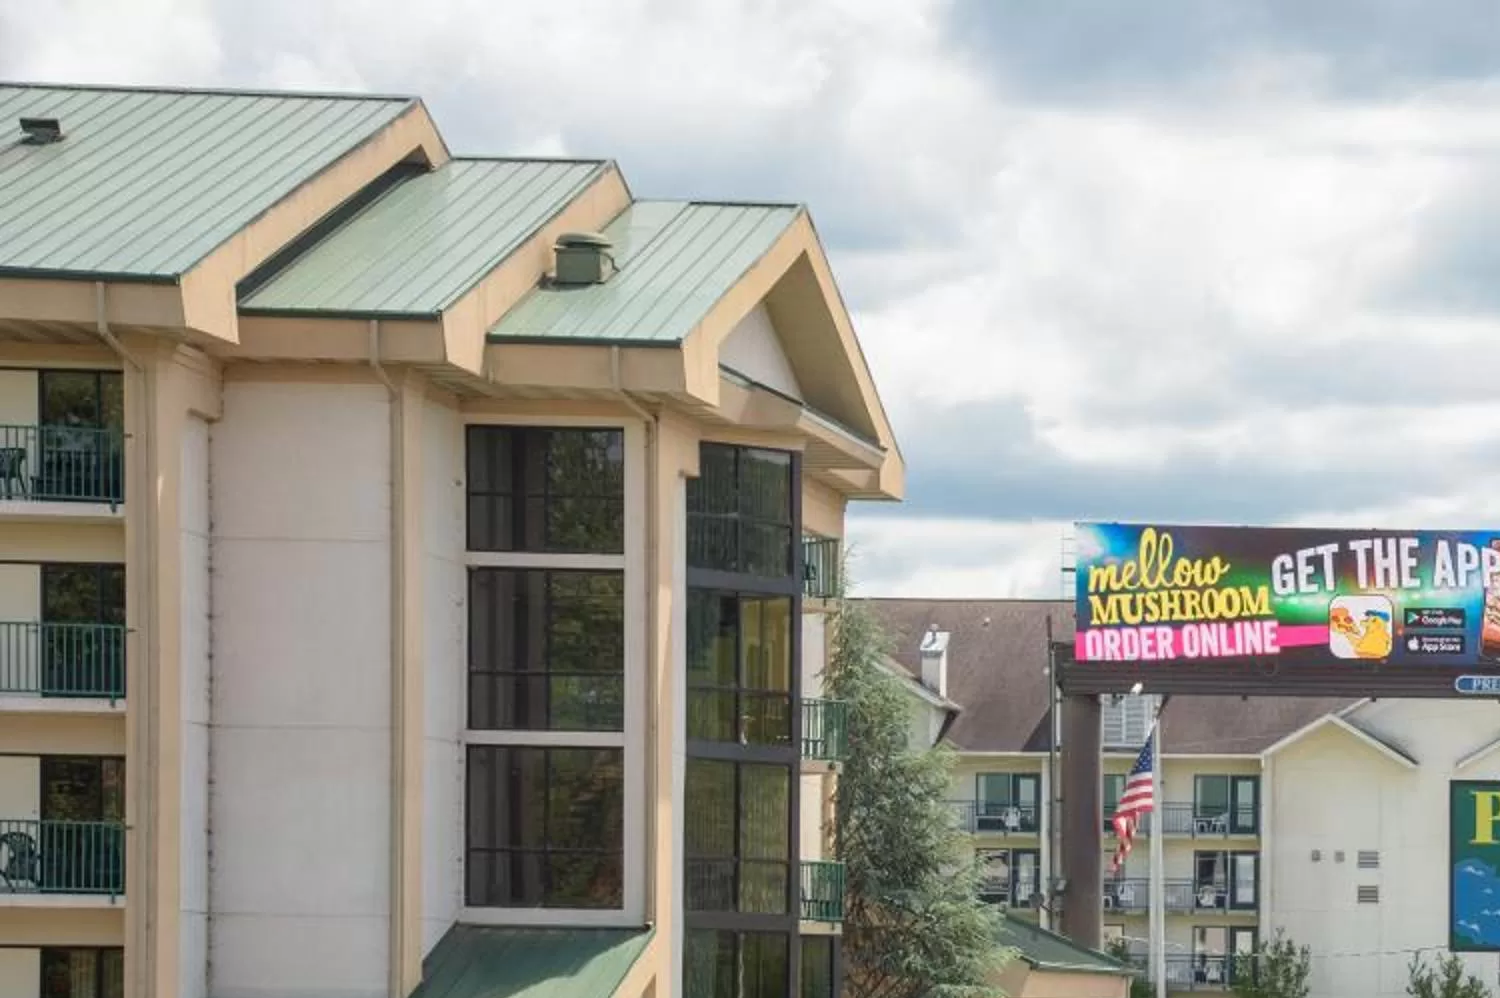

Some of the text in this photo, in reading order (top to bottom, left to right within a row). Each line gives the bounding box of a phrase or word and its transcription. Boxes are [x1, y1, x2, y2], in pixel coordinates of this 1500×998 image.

[1088, 527, 1231, 592] mellow
[1271, 543, 1338, 595] GET
[1349, 537, 1420, 588] THE
[1088, 585, 1273, 625] MUSHROOM
[1085, 620, 1280, 660] ORDER ONLINE
